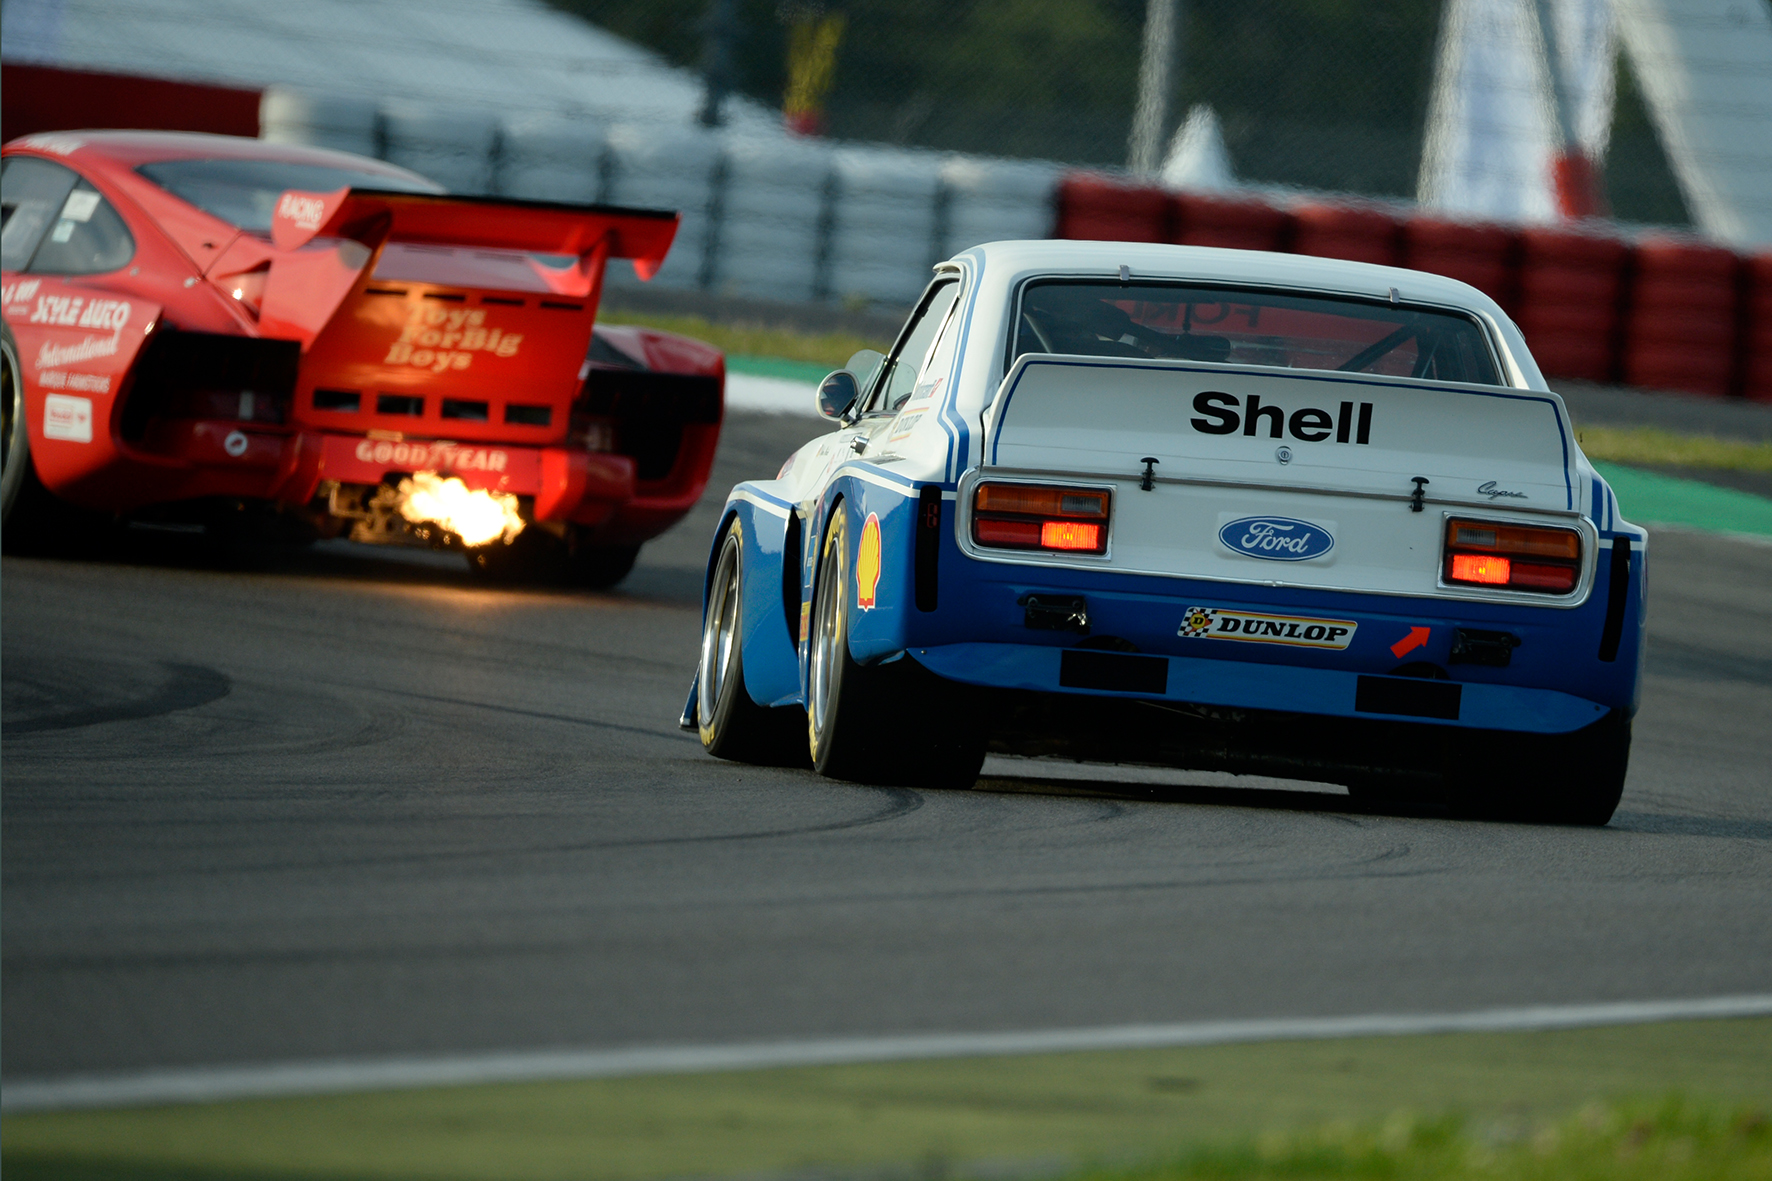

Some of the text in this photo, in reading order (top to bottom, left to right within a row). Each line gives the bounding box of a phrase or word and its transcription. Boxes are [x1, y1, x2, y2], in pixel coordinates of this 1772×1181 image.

[278, 194, 324, 222] RACING
[30, 295, 132, 331] STYLE AUTO
[405, 300, 487, 332] Toys
[384, 342, 473, 373] Boys
[1190, 391, 1373, 445] Shell
[355, 440, 508, 472] GOODYEAR
[1477, 480, 1529, 500] Capri
[1241, 521, 1311, 553] Ford
[1217, 617, 1348, 641] DUNLOP
